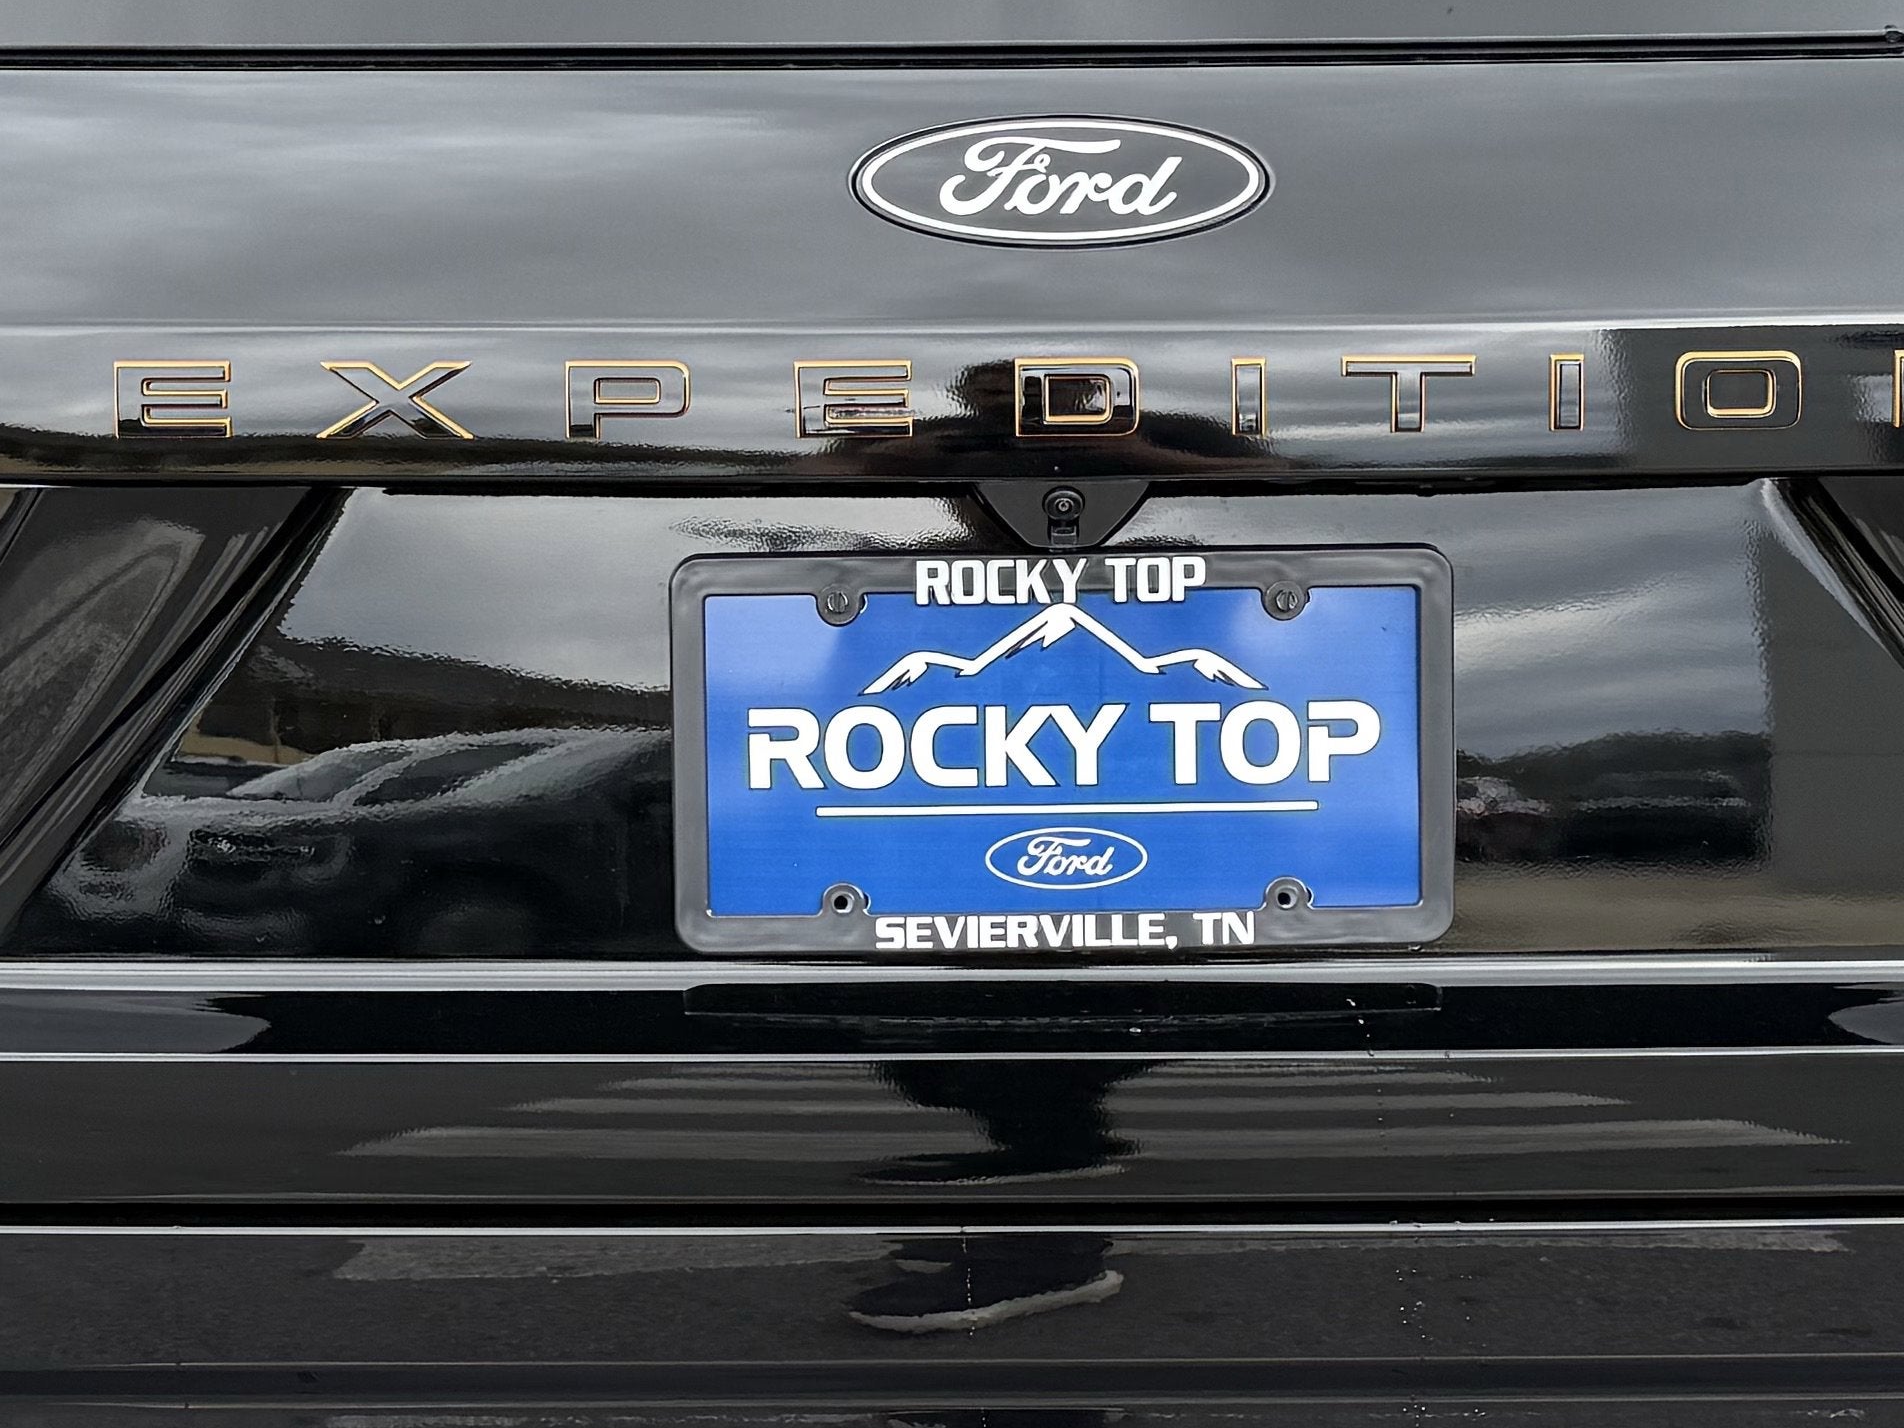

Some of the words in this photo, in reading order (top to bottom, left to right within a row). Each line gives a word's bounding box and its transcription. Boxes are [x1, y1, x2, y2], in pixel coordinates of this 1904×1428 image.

[939, 136, 1183, 216] Ford
[914, 556, 1089, 606] ROCKY
[1106, 556, 1207, 604] TOP
[746, 703, 1130, 791] ROCKY
[1150, 700, 1383, 786] TOP
[1017, 836, 1115, 878] Ford
[875, 913, 1178, 950] SEVIERVILLE,
[1193, 912, 1255, 946] TN
